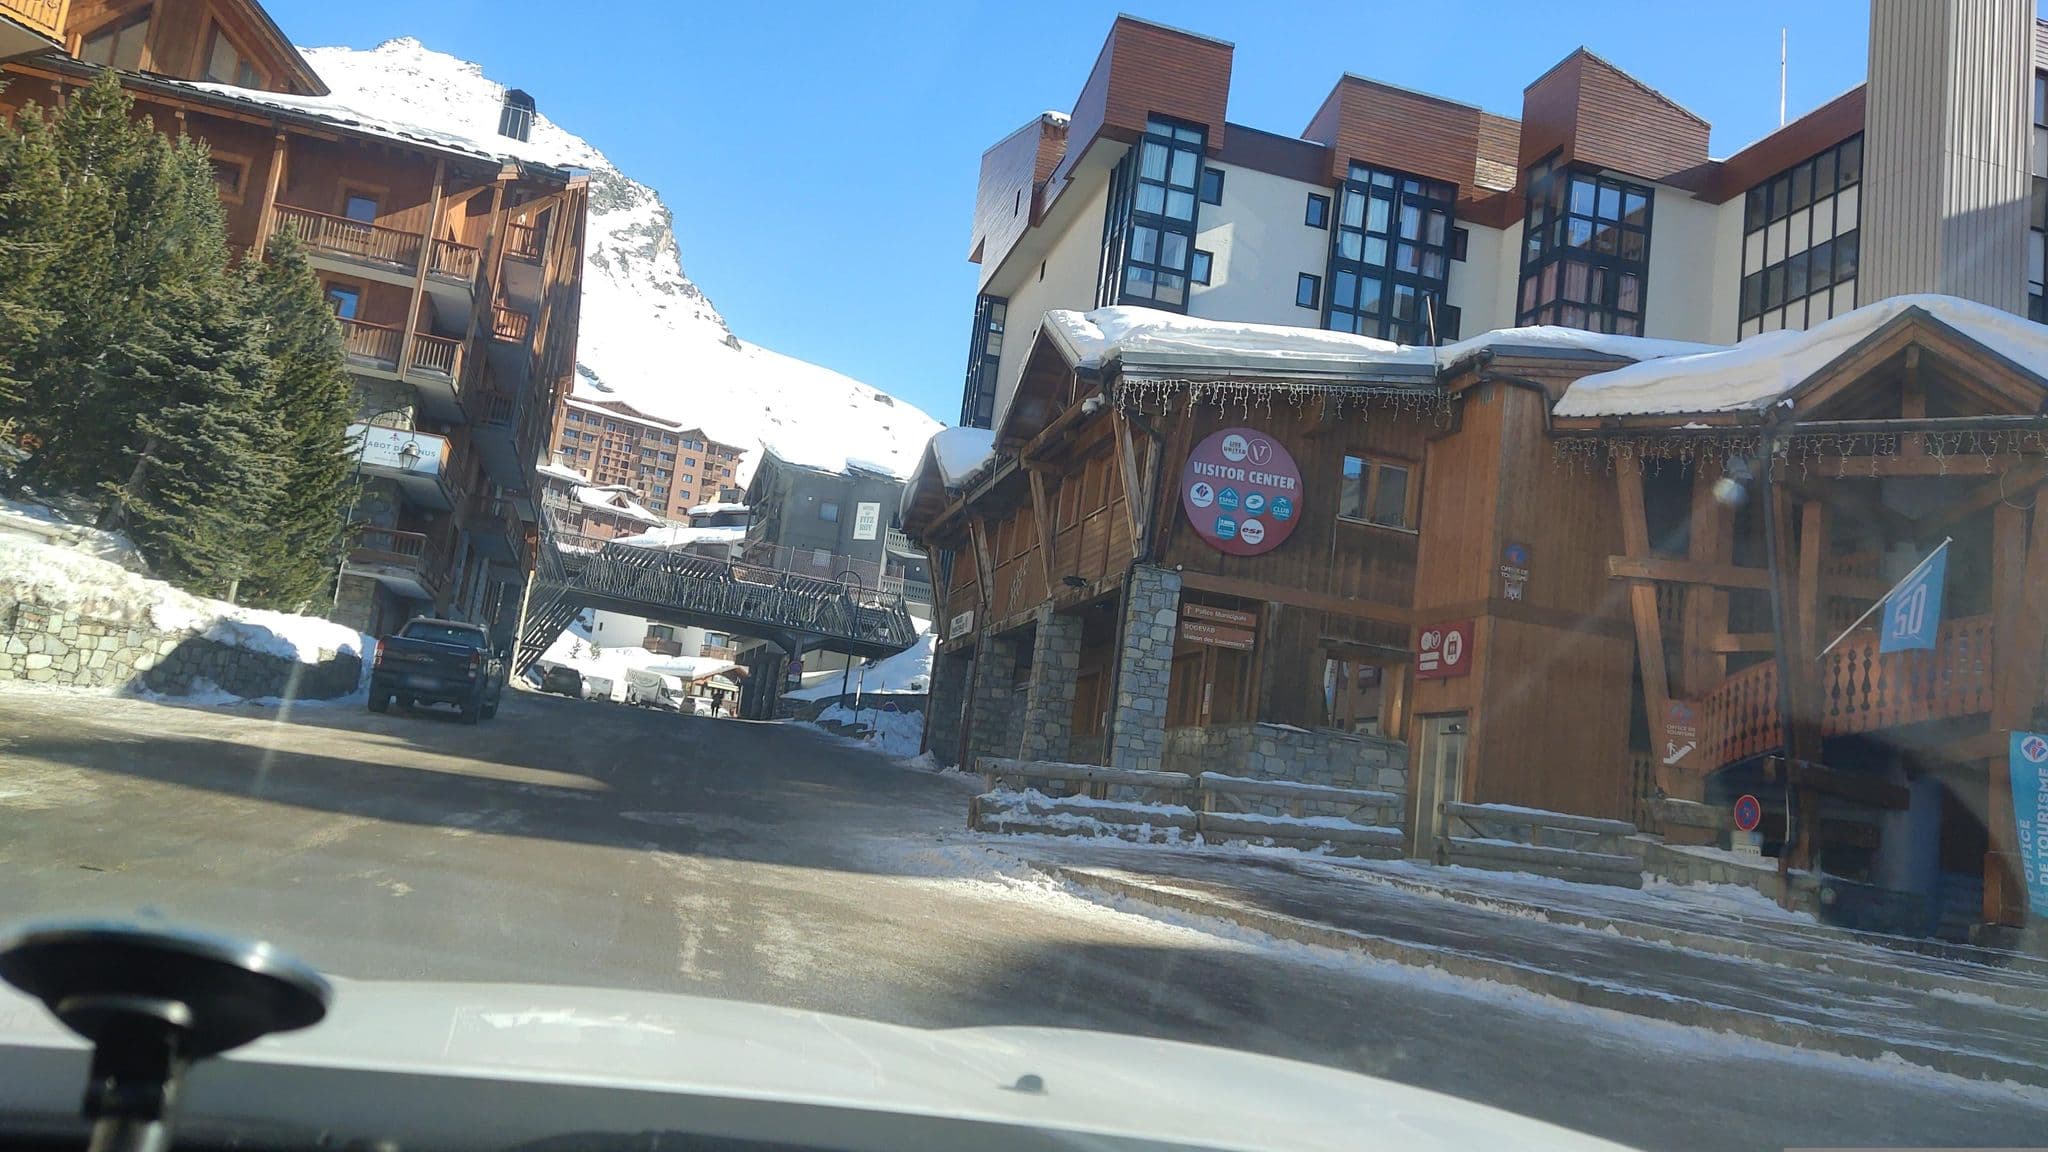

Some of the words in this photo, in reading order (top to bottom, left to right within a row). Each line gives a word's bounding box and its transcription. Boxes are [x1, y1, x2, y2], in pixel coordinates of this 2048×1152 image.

[1193, 461, 1245, 482] VISITOR
[1248, 470, 1296, 490] CENTER
[1272, 505, 1290, 514] CLUB
[1195, 607, 1214, 617] Police
[1893, 582, 1927, 639] 50
[2037, 767, 2048, 859] TOURISME
[2020, 819, 2034, 882] OFFICE
[2039, 863, 2048, 885] DE
